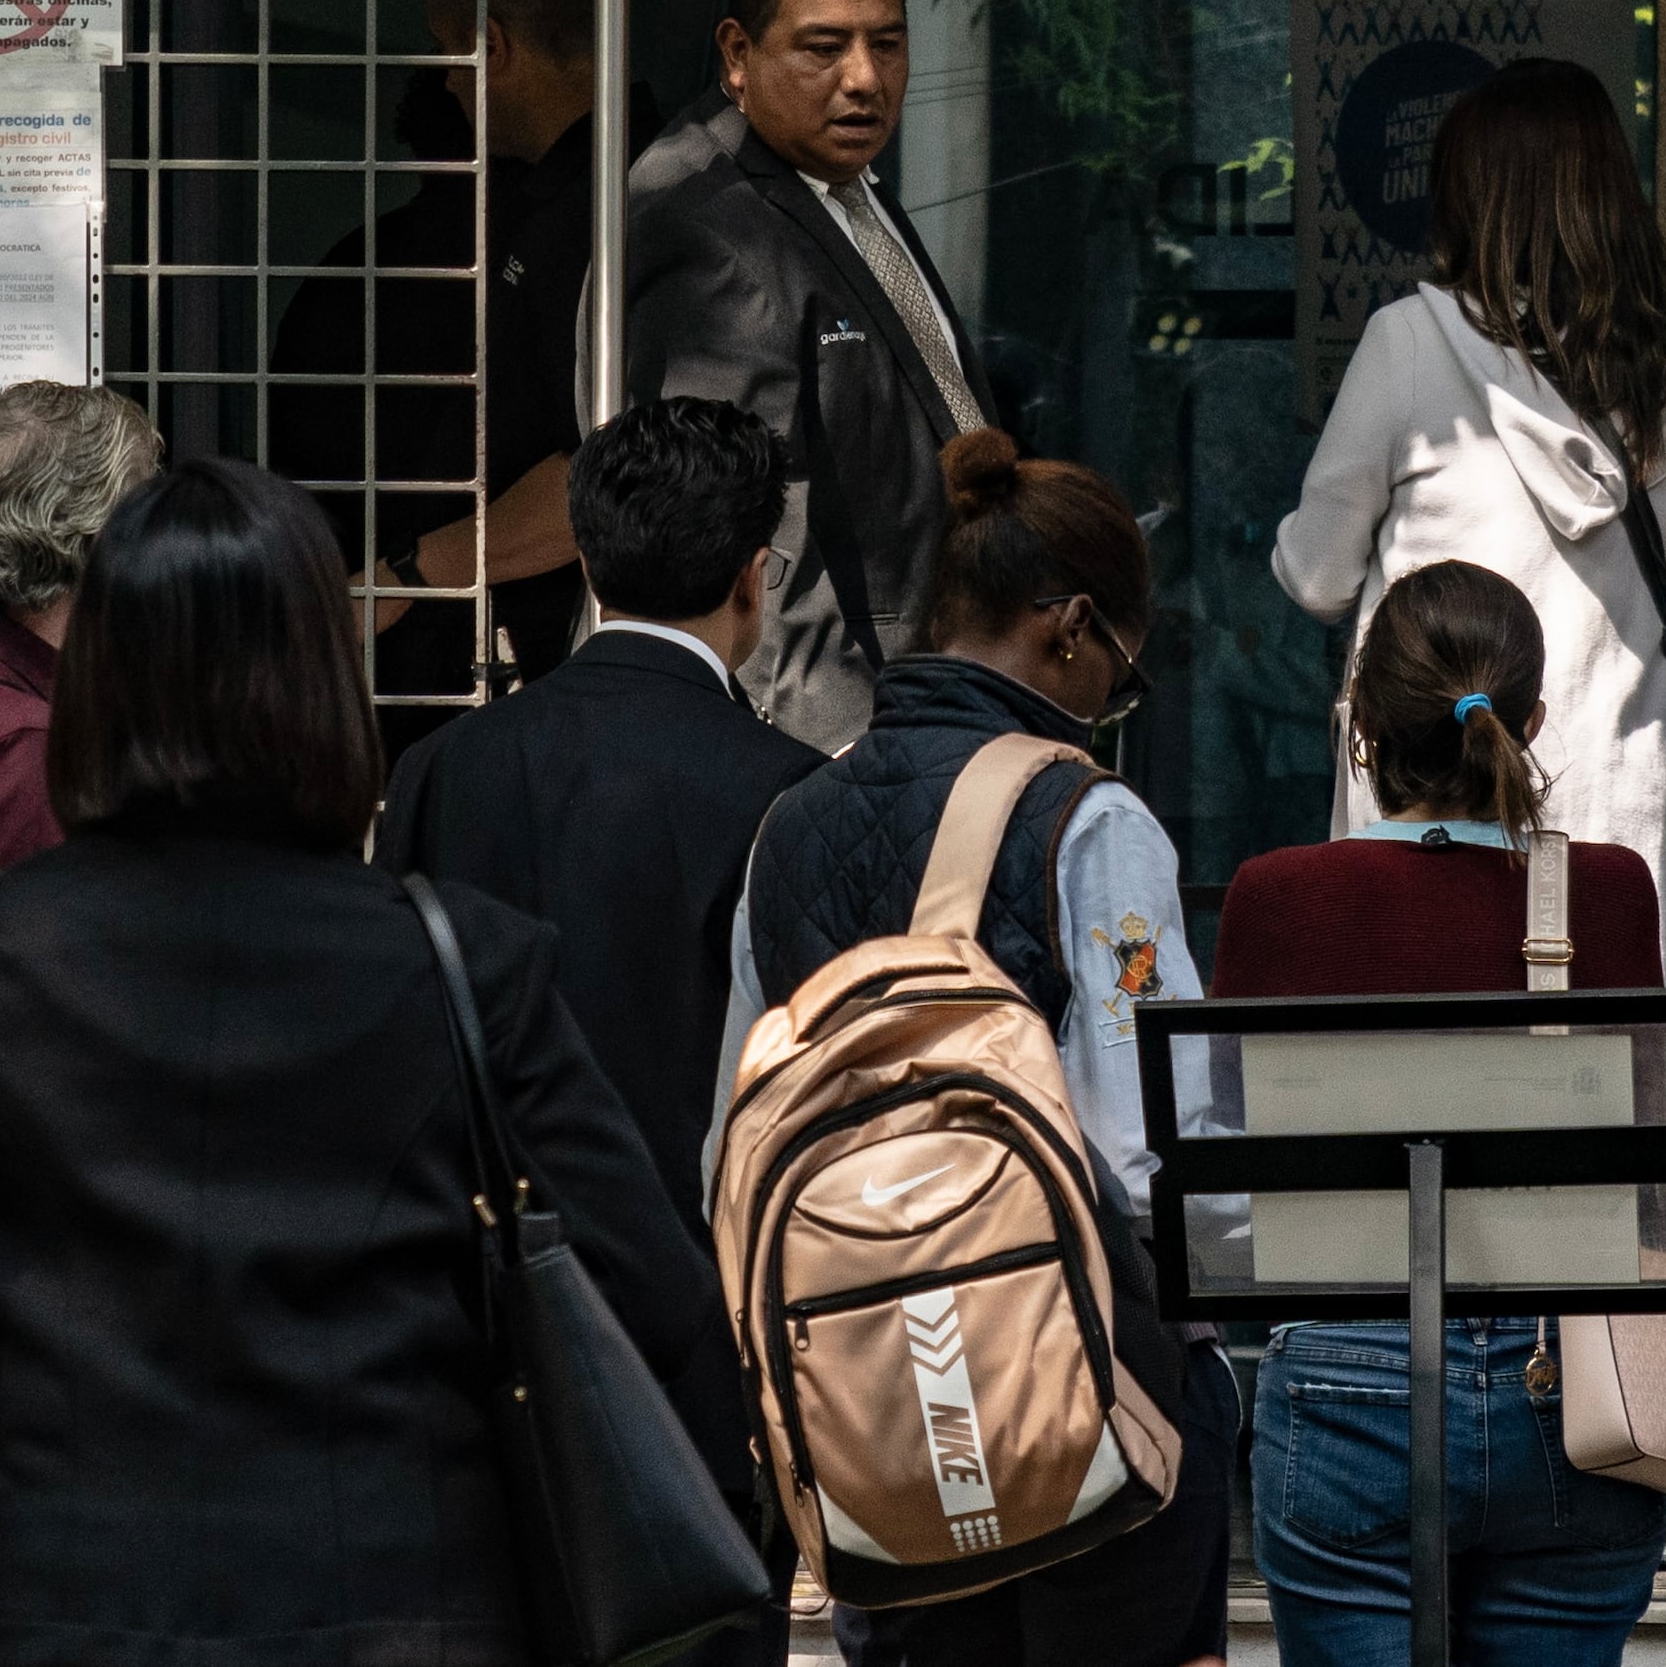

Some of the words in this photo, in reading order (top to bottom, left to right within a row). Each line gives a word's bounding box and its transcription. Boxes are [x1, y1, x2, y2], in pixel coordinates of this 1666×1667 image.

[37, 16, 76, 26] estar
[80, 17, 89, 29] y
[72, 113, 91, 126] de
[42, 132, 72, 145] civil
[6, 156, 12, 164] y
[16, 155, 53, 164] recoger
[58, 153, 91, 162] ACTAS
[8, 169, 21, 177] sin
[24, 169, 41, 177] cita
[44, 169, 73, 177] previa
[76, 167, 91, 176] de
[11, 185, 48, 193] excepto
[52, 183, 91, 192] festivos,
[926, 1401, 984, 1487] NIKE
